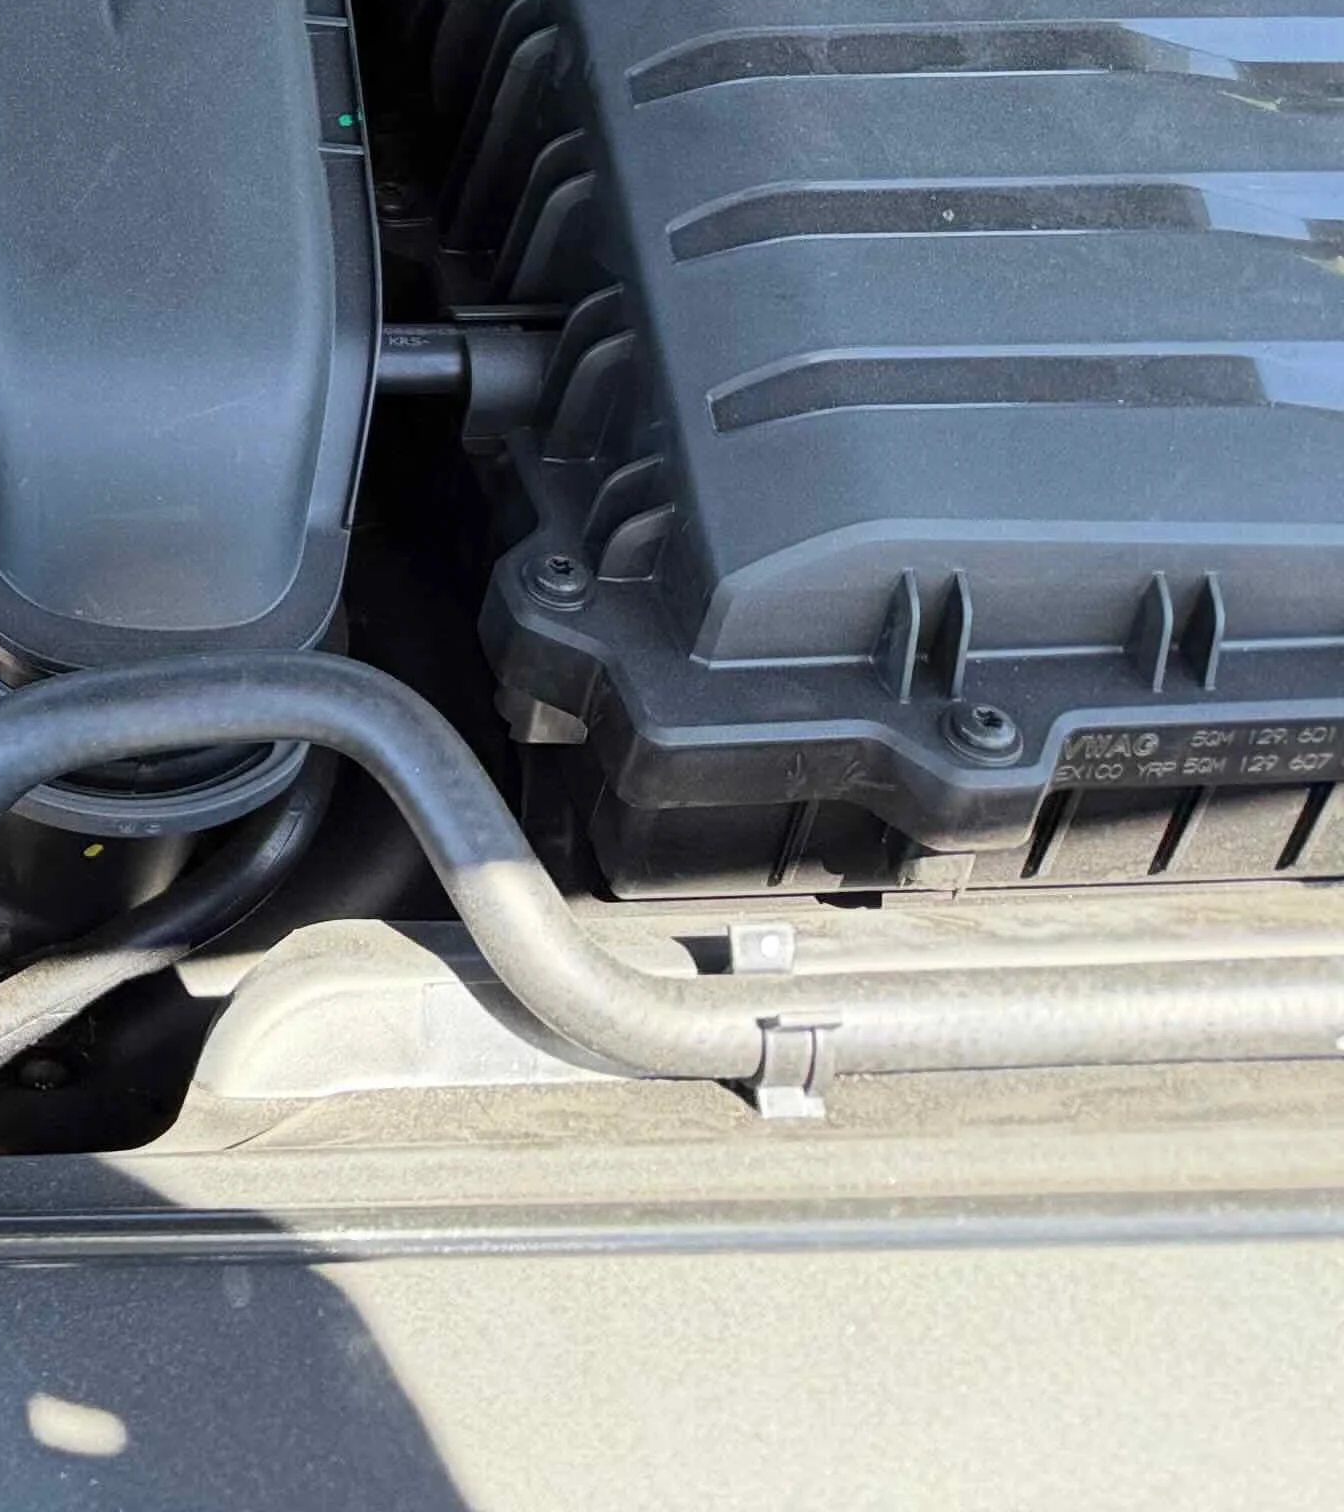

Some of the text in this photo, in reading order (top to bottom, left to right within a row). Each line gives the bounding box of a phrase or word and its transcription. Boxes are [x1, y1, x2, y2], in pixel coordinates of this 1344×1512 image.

[1063, 732, 1160, 761] VWAG
[1296, 725, 1337, 744] 601
[1239, 754, 1280, 774] 129
